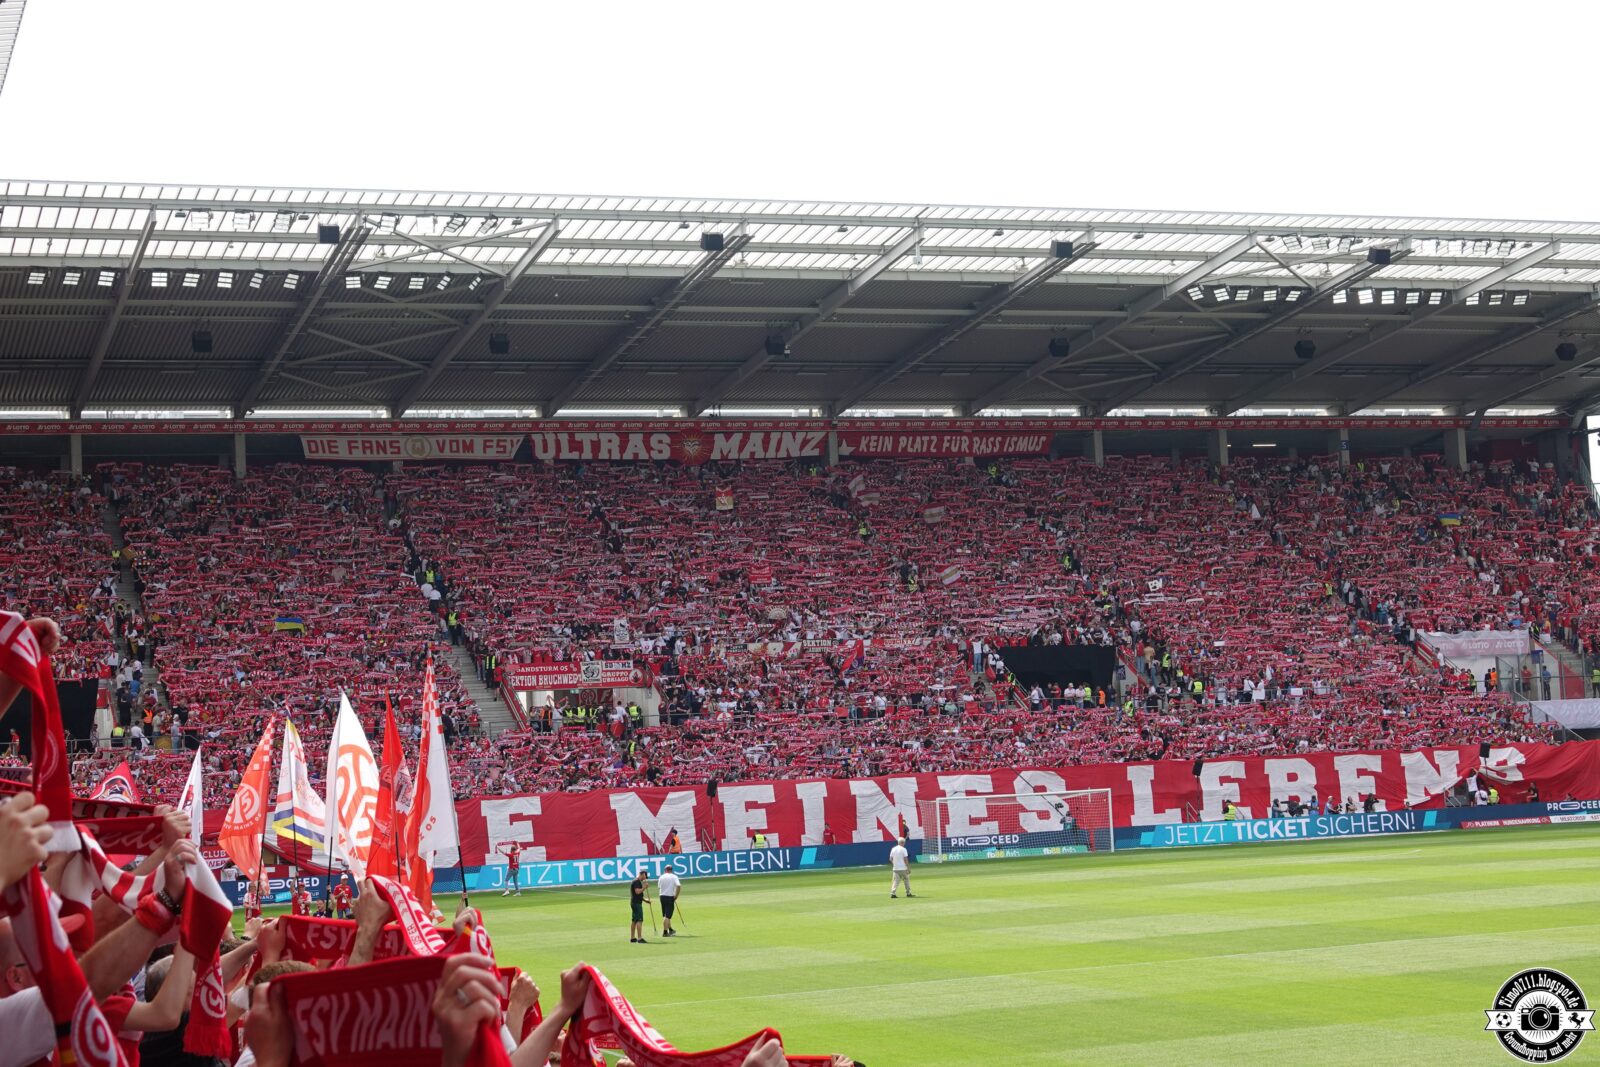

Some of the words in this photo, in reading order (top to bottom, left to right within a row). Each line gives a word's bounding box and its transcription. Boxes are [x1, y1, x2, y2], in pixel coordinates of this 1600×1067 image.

[306, 439, 339, 455] DIE
[347, 439, 401, 455] FANS
[436, 439, 475, 454] VOM
[532, 433, 671, 460] ULTRAS
[710, 432, 826, 460] MAINZ
[860, 435, 893, 452] KEIN
[898, 435, 937, 453] PLATZ
[942, 435, 970, 453] FÜR
[1468, 640, 1490, 649] LOTTO
[1504, 640, 1525, 649] LOTTO
[510, 675, 536, 687] EKTION
[1166, 824, 1225, 846] JETZT
[1232, 818, 1312, 840] TICKET
[1316, 812, 1416, 836] SICHERN!
[950, 834, 1020, 846] PROCEED
[573, 857, 673, 881] TICKET
[672, 848, 791, 877] SICHERN!
[294, 991, 351, 1062] FSV
